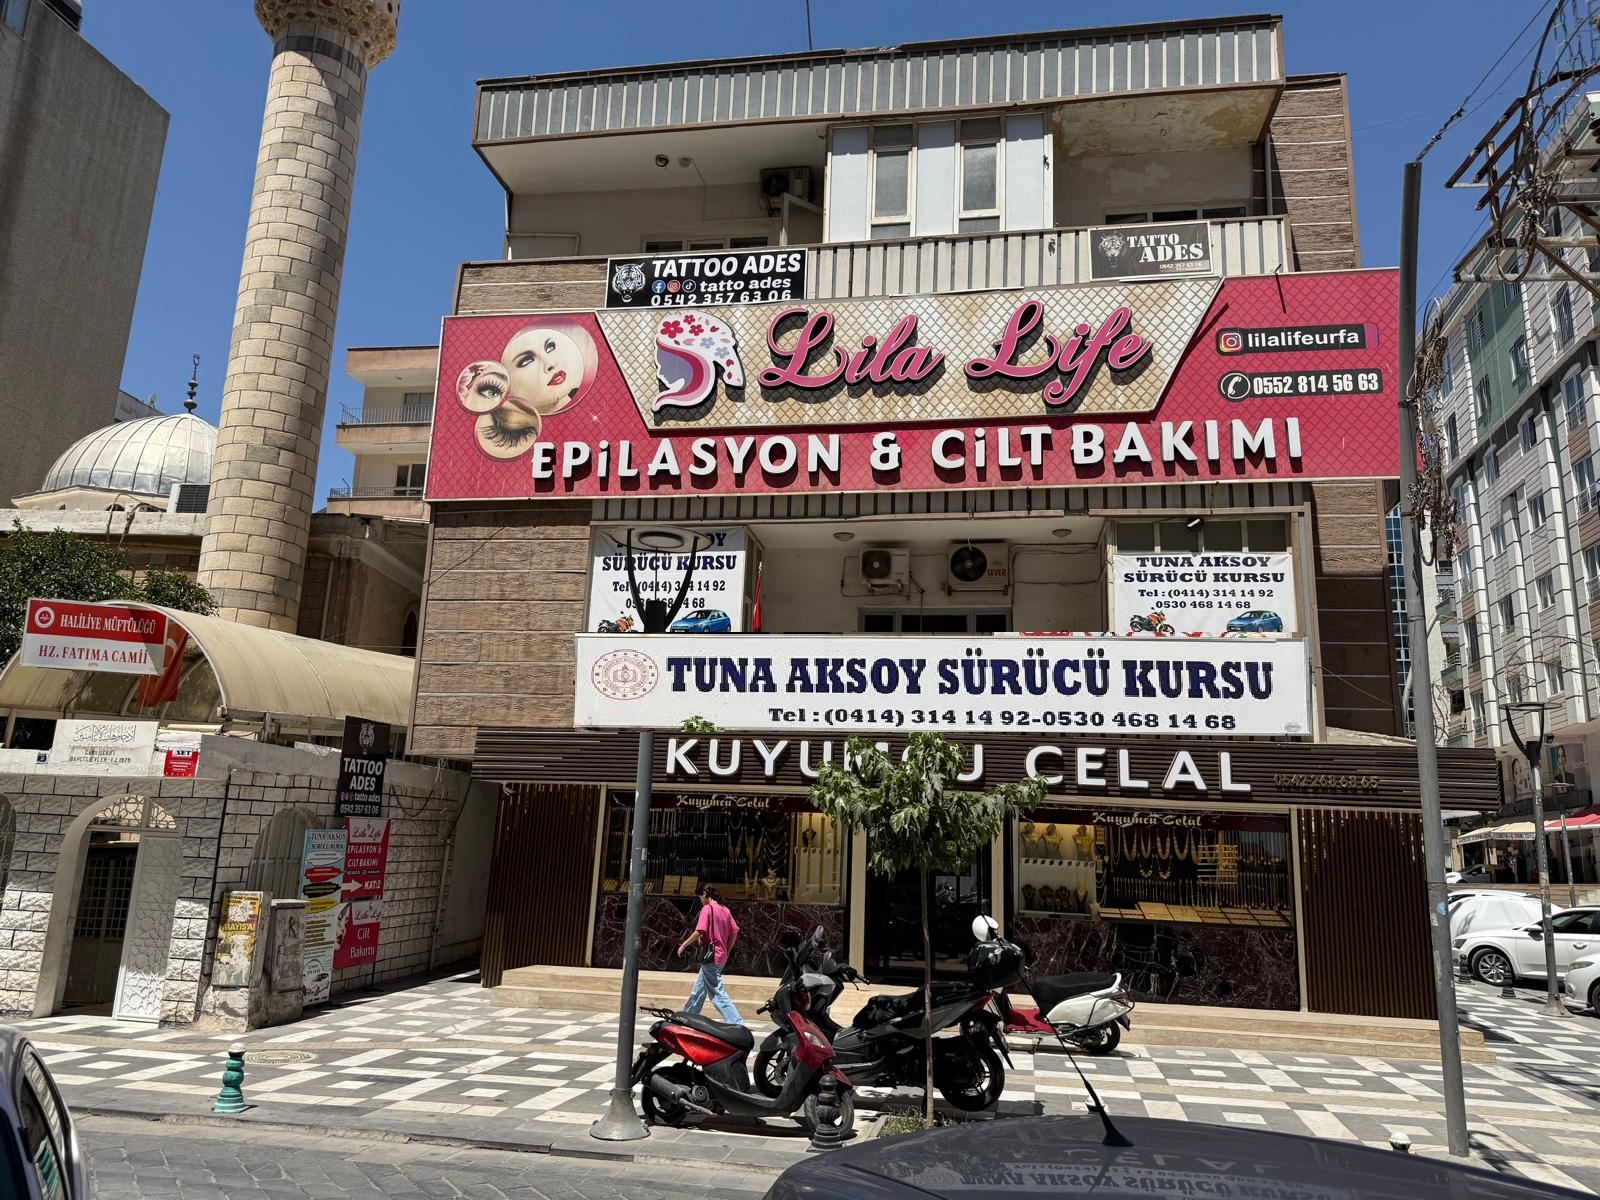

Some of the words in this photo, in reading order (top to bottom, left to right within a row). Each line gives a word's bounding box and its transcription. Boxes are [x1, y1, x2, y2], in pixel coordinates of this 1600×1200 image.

[1126, 233, 1180, 248] TATTO
[1139, 243, 1204, 263] ADES
[652, 256, 739, 278] TATTOO
[742, 253, 802, 276] ADES
[700, 280, 745, 293] tatto
[748, 276, 792, 289] ades
[650, 294, 697, 307] 0542
[702, 292, 734, 305] 357
[740, 290, 762, 303] 63
[768, 289, 792, 302] 06
[1248, 329, 1360, 348] lilalifeurfa
[758, 306, 946, 389] Lila
[964, 299, 1153, 405] Life
[1253, 376, 1294, 395] 0552
[1297, 375, 1329, 394] 814
[1332, 373, 1354, 392] 56
[1357, 372, 1379, 391] 63
[870, 431, 902, 471] &
[1070, 417, 1302, 466] BAKIMI
[1136, 556, 1195, 568] TUNA
[1198, 556, 1271, 567] AKSOY
[1124, 569, 1208, 583] SÜRÜCÜ
[1212, 572, 1285, 583] KURSU
[697, 580, 710, 592] 14
[712, 580, 726, 591] 92
[1168, 589, 1210, 599] (0414)
[1212, 589, 1237, 597] 314
[1240, 589, 1255, 597] 14
[1258, 589, 1274, 597] 92
[692, 597, 705, 609] 68
[1155, 601, 1187, 609] 0530
[1190, 600, 1214, 609] 468
[1217, 600, 1233, 609] 14
[1235, 600, 1251, 609] 68
[60, 612, 101, 629] HALİLİYE
[103, 615, 156, 635] MÜFTÜLÜĞÜ
[38, 644, 60, 658] HZ.
[62, 646, 109, 662] FATIMA
[111, 649, 148, 664] CAMİİ
[666, 656, 777, 693] TUNA
[785, 657, 927, 695] AKSOY
[938, 647, 1110, 697] SÜRÜCÜ
[1121, 660, 1274, 700] KURSU
[769, 708, 806, 723] Tel
[824, 708, 904, 727] (0414)
[911, 709, 956, 724] 314
[966, 709, 993, 725] 14
[1000, 710, 1104, 727] 92-0530
[1111, 712, 1159, 728] 468
[1169, 713, 1198, 729] 14
[1205, 714, 1236, 730] 68
[343, 758, 384, 775] TATTOO
[1025, 744, 1251, 793] CELAL
[349, 775, 376, 791] ADES
[357, 928, 370, 940] Cilt
